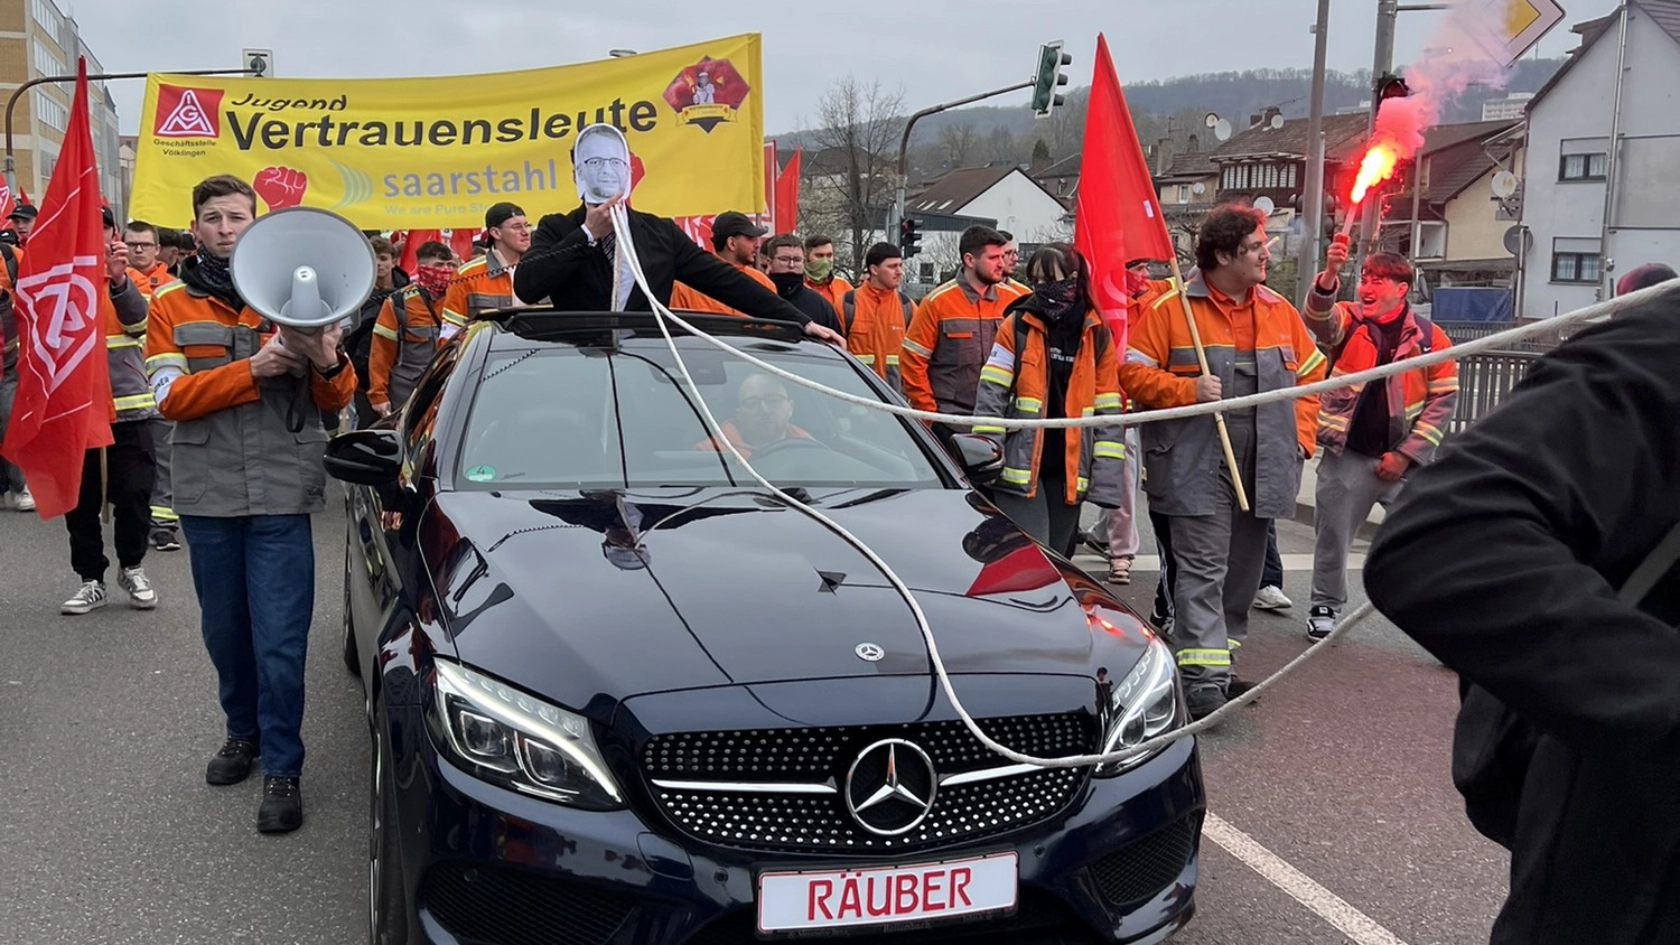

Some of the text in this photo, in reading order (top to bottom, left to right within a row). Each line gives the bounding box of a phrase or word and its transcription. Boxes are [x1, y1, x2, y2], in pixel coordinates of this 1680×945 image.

[231, 93, 347, 111] Jugend
[225, 97, 657, 150] Vertrauensleute
[153, 139, 217, 147] Geschäftsstelle
[162, 149, 206, 158] Völklingen
[383, 159, 557, 197] saarstahl
[385, 205, 405, 215] We
[410, 206, 431, 215] are
[435, 204, 466, 214] Pure
[807, 867, 972, 921] RÄUBER
